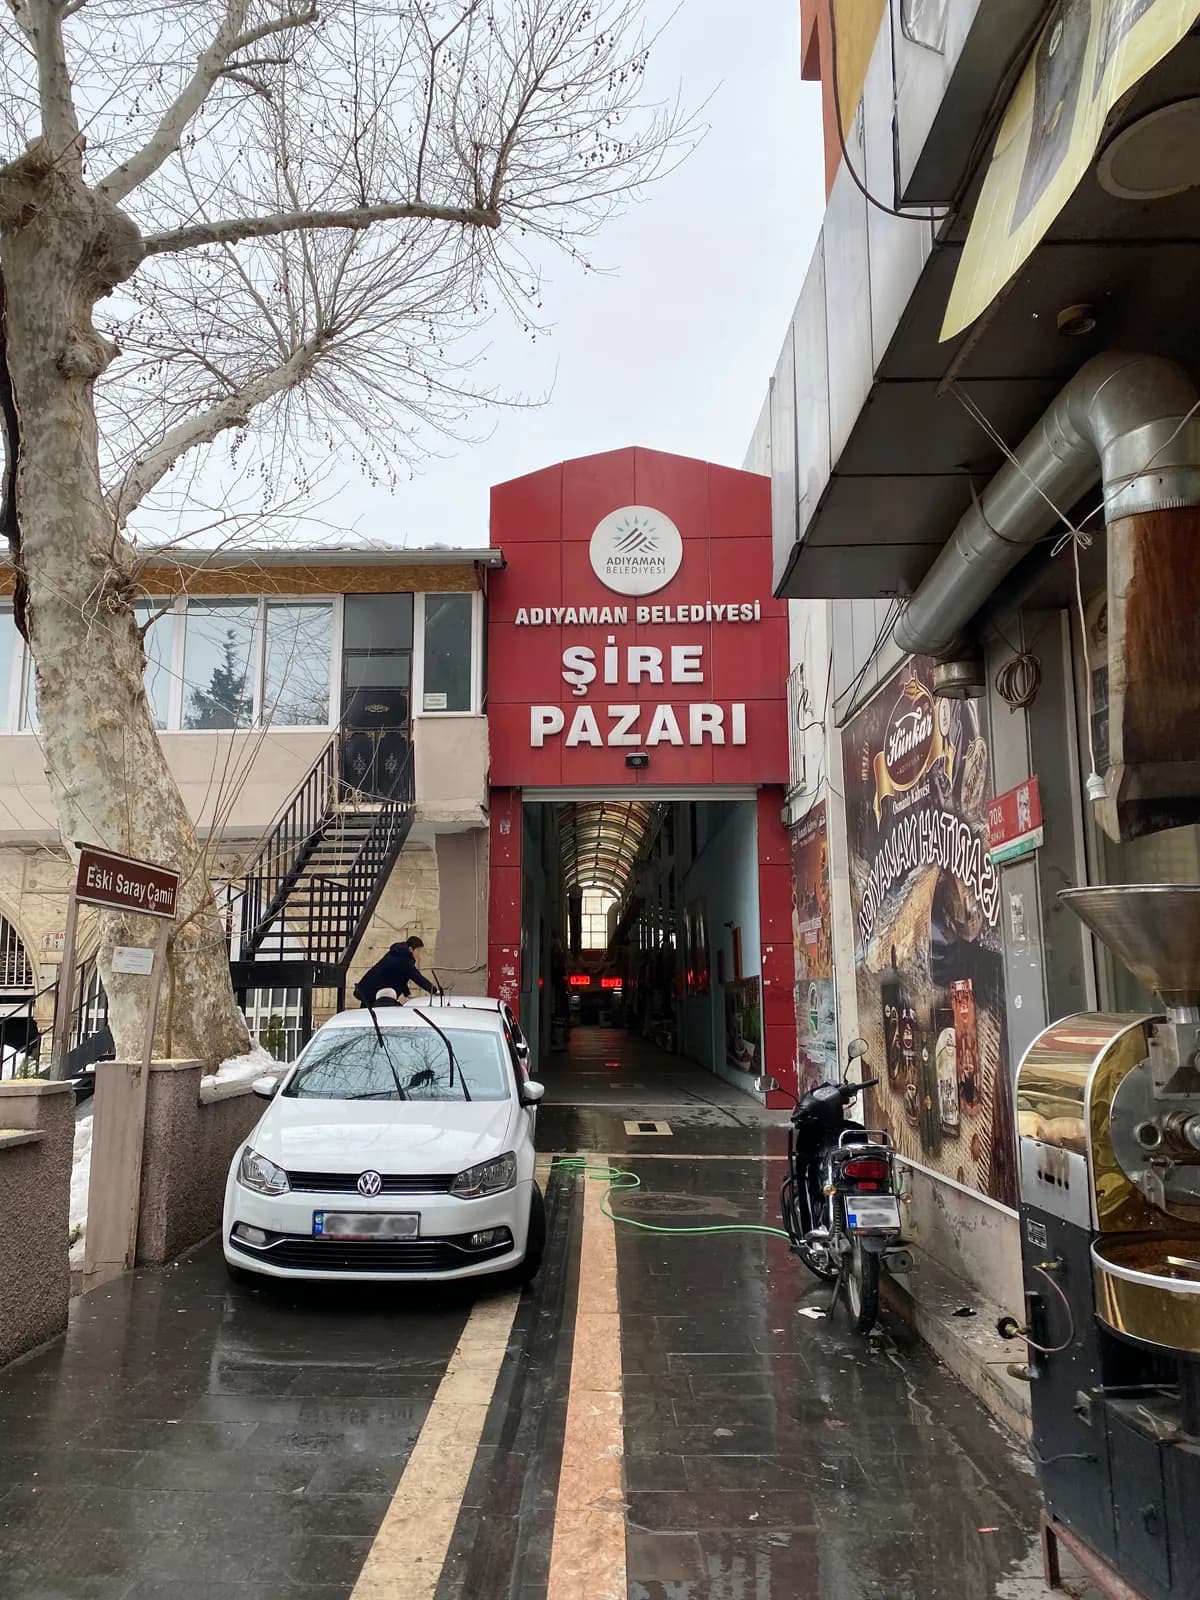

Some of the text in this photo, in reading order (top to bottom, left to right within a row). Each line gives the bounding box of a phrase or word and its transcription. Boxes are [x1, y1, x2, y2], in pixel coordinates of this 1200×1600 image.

[606, 556, 666, 566] ADIYAMAN
[514, 600, 761, 625] ADIYAMAN BELEDİYESİ
[561, 635, 704, 696] ŞİRE
[530, 703, 746, 747] PAZARI
[86, 866, 174, 905] Eski Saray Camii
[919, 808, 1000, 926] HATIRASI
